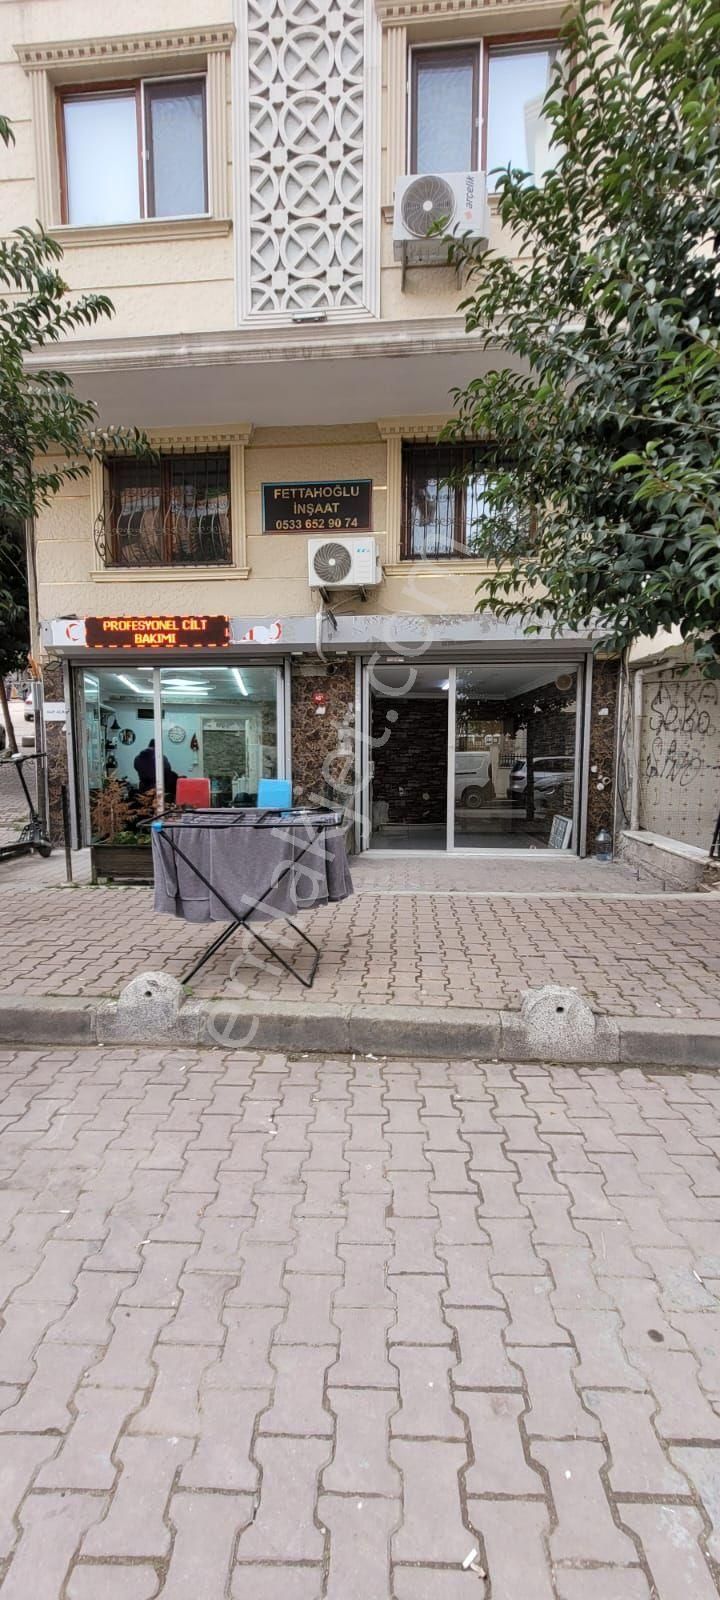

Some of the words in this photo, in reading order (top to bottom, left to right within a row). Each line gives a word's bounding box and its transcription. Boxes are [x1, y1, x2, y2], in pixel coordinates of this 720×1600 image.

[273, 485, 360, 499] FETTAHOĞLU
[293, 502, 340, 516] İNŞAAT
[275, 520, 302, 530] 0533
[305, 519, 325, 529] 652
[328, 518, 341, 528] 90
[345, 518, 358, 527] 74
[103, 619, 179, 631] PROFESYONEL
[182, 618, 208, 630] CİLT
[134, 633, 176, 644] BAKIMI
